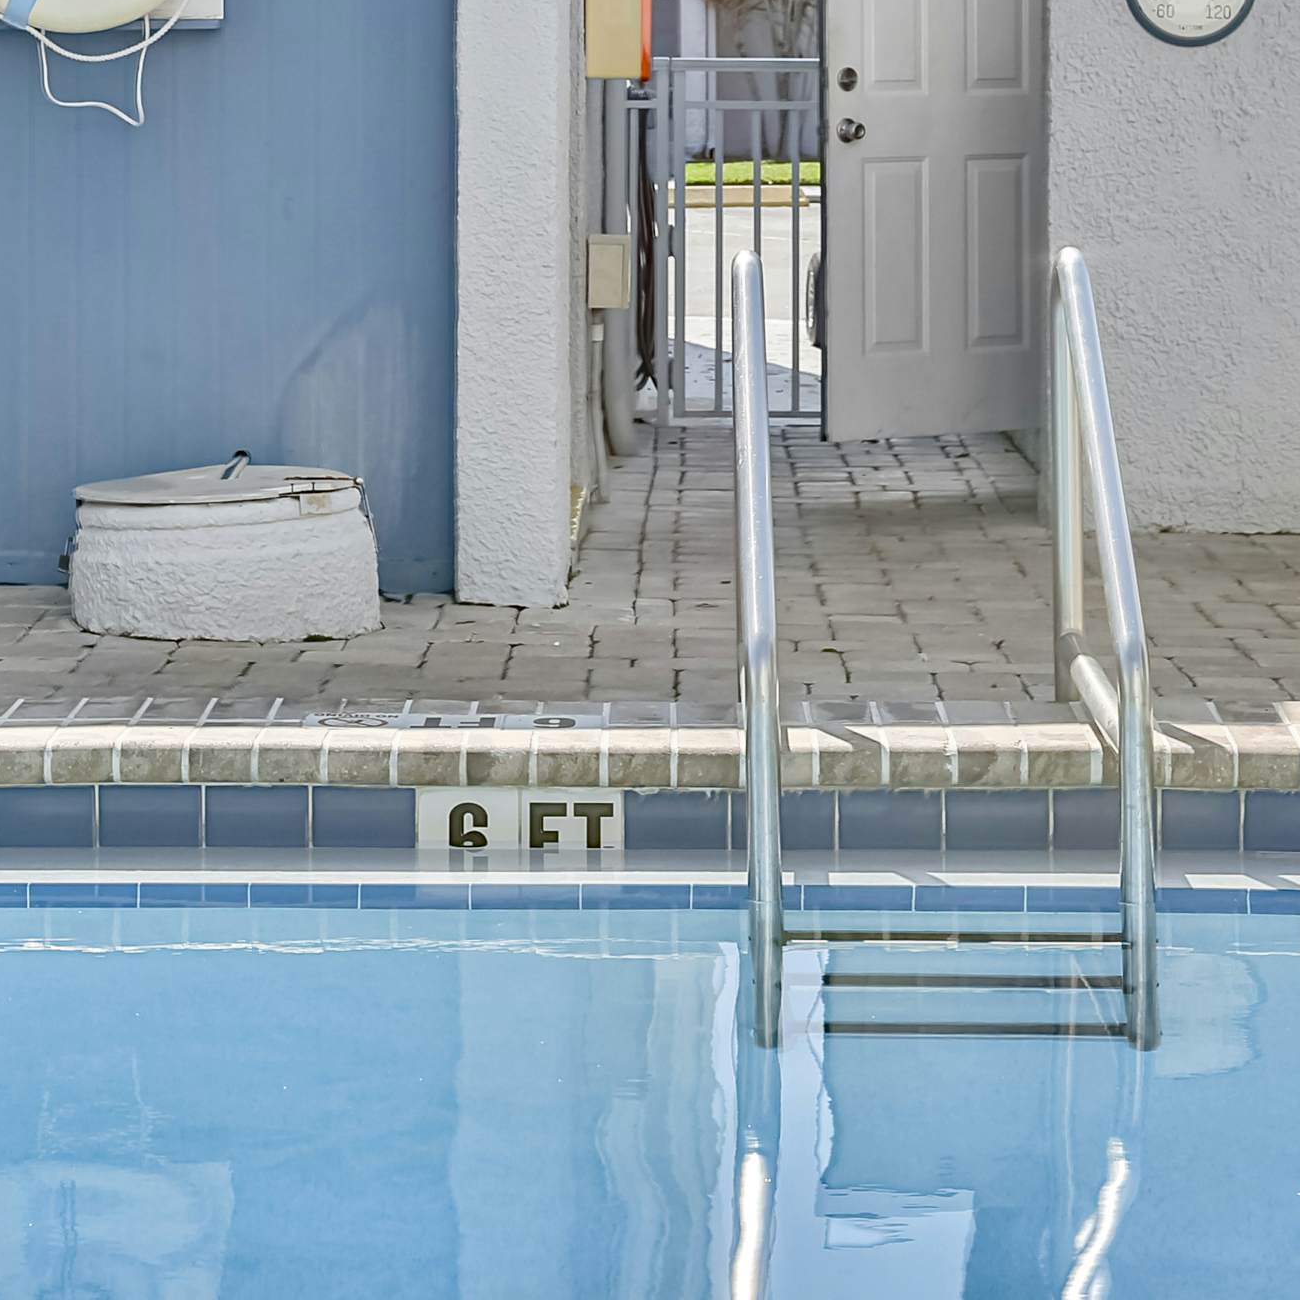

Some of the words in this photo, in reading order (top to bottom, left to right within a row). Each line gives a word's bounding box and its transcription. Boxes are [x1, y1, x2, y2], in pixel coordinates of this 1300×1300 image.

[1206, 5, 1232, 20] 120
[410, 717, 497, 729] FT
[533, 717, 576, 729] 6
[449, 802, 489, 848] 6
[529, 802, 614, 848] FT
